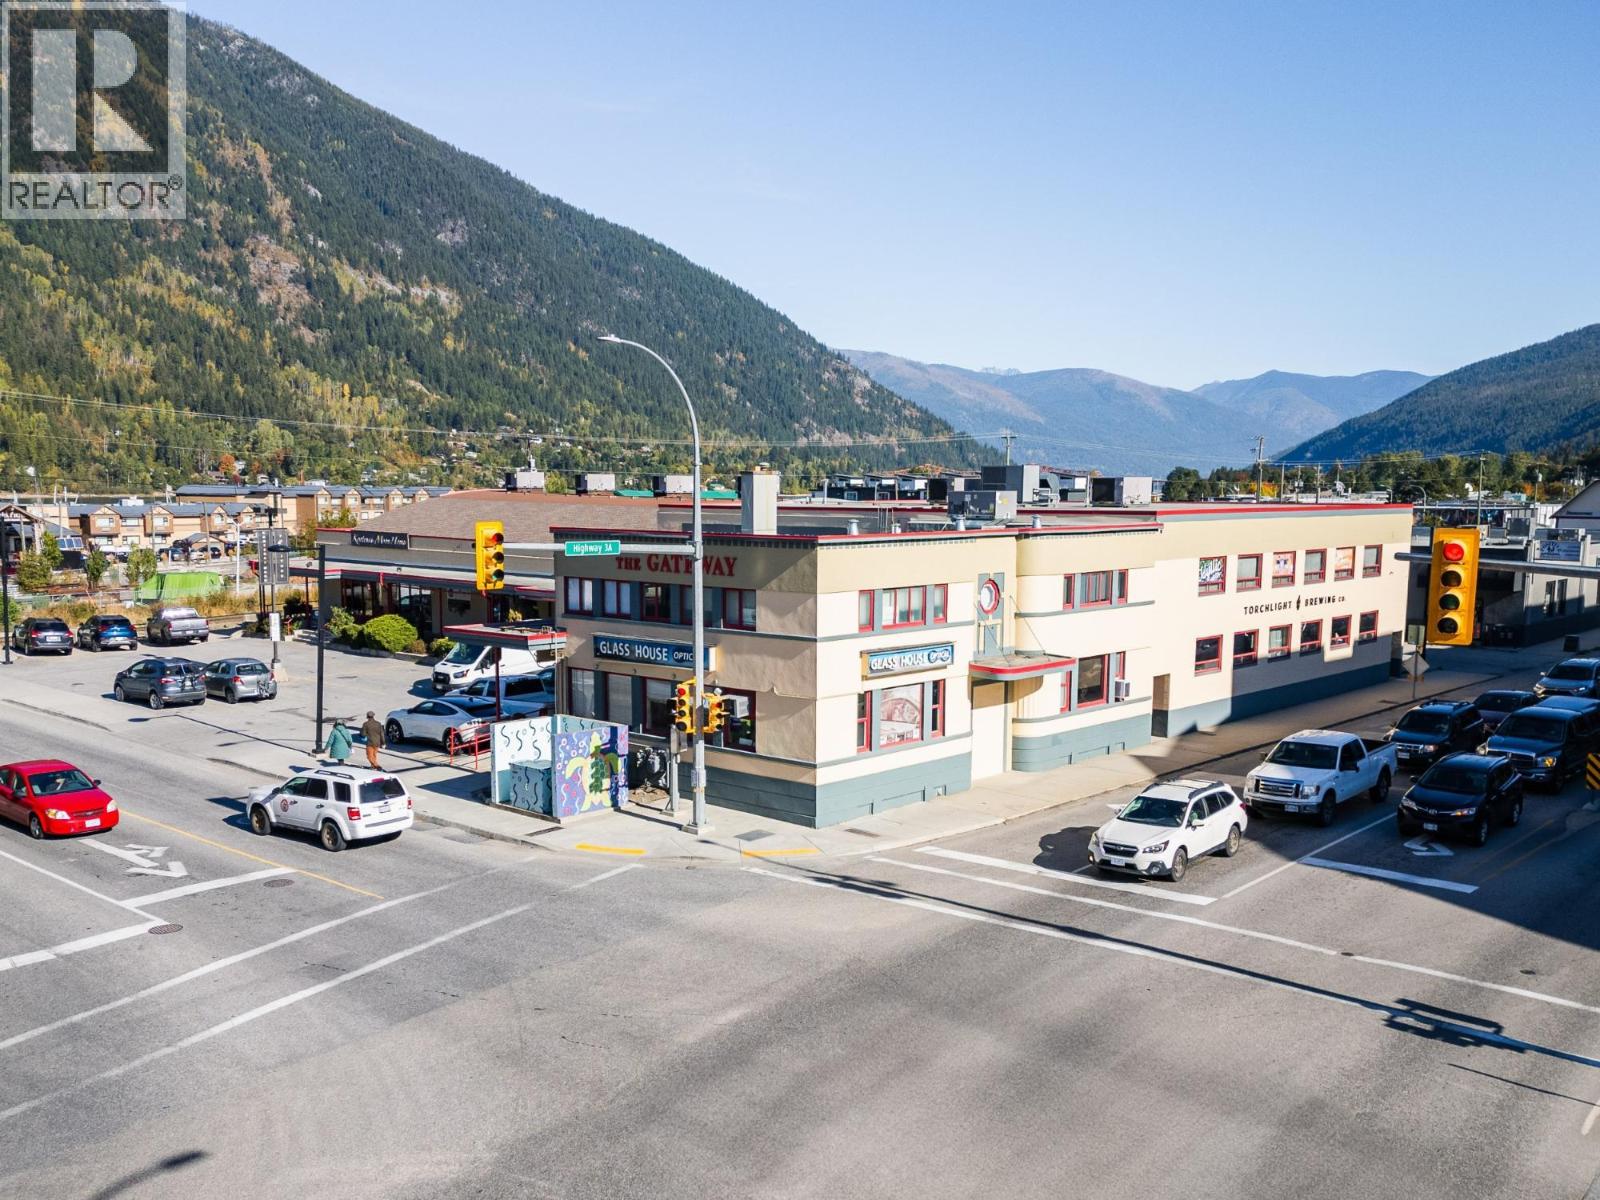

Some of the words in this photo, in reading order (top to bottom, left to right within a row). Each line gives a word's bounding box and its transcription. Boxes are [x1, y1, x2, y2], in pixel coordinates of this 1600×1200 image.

[573, 543, 603, 555] Highway
[604, 543, 613, 552] 3A
[616, 556, 642, 571] THE
[1243, 600, 1292, 615] TORCHLIGHT
[1304, 595, 1336, 607] BREWING
[599, 641, 630, 657] GLASS
[635, 644, 668, 661] HOUSE
[673, 651, 694, 661] OPTIC
[870, 656, 897, 670] GLASS
[900, 653, 927, 667] HOUSE
